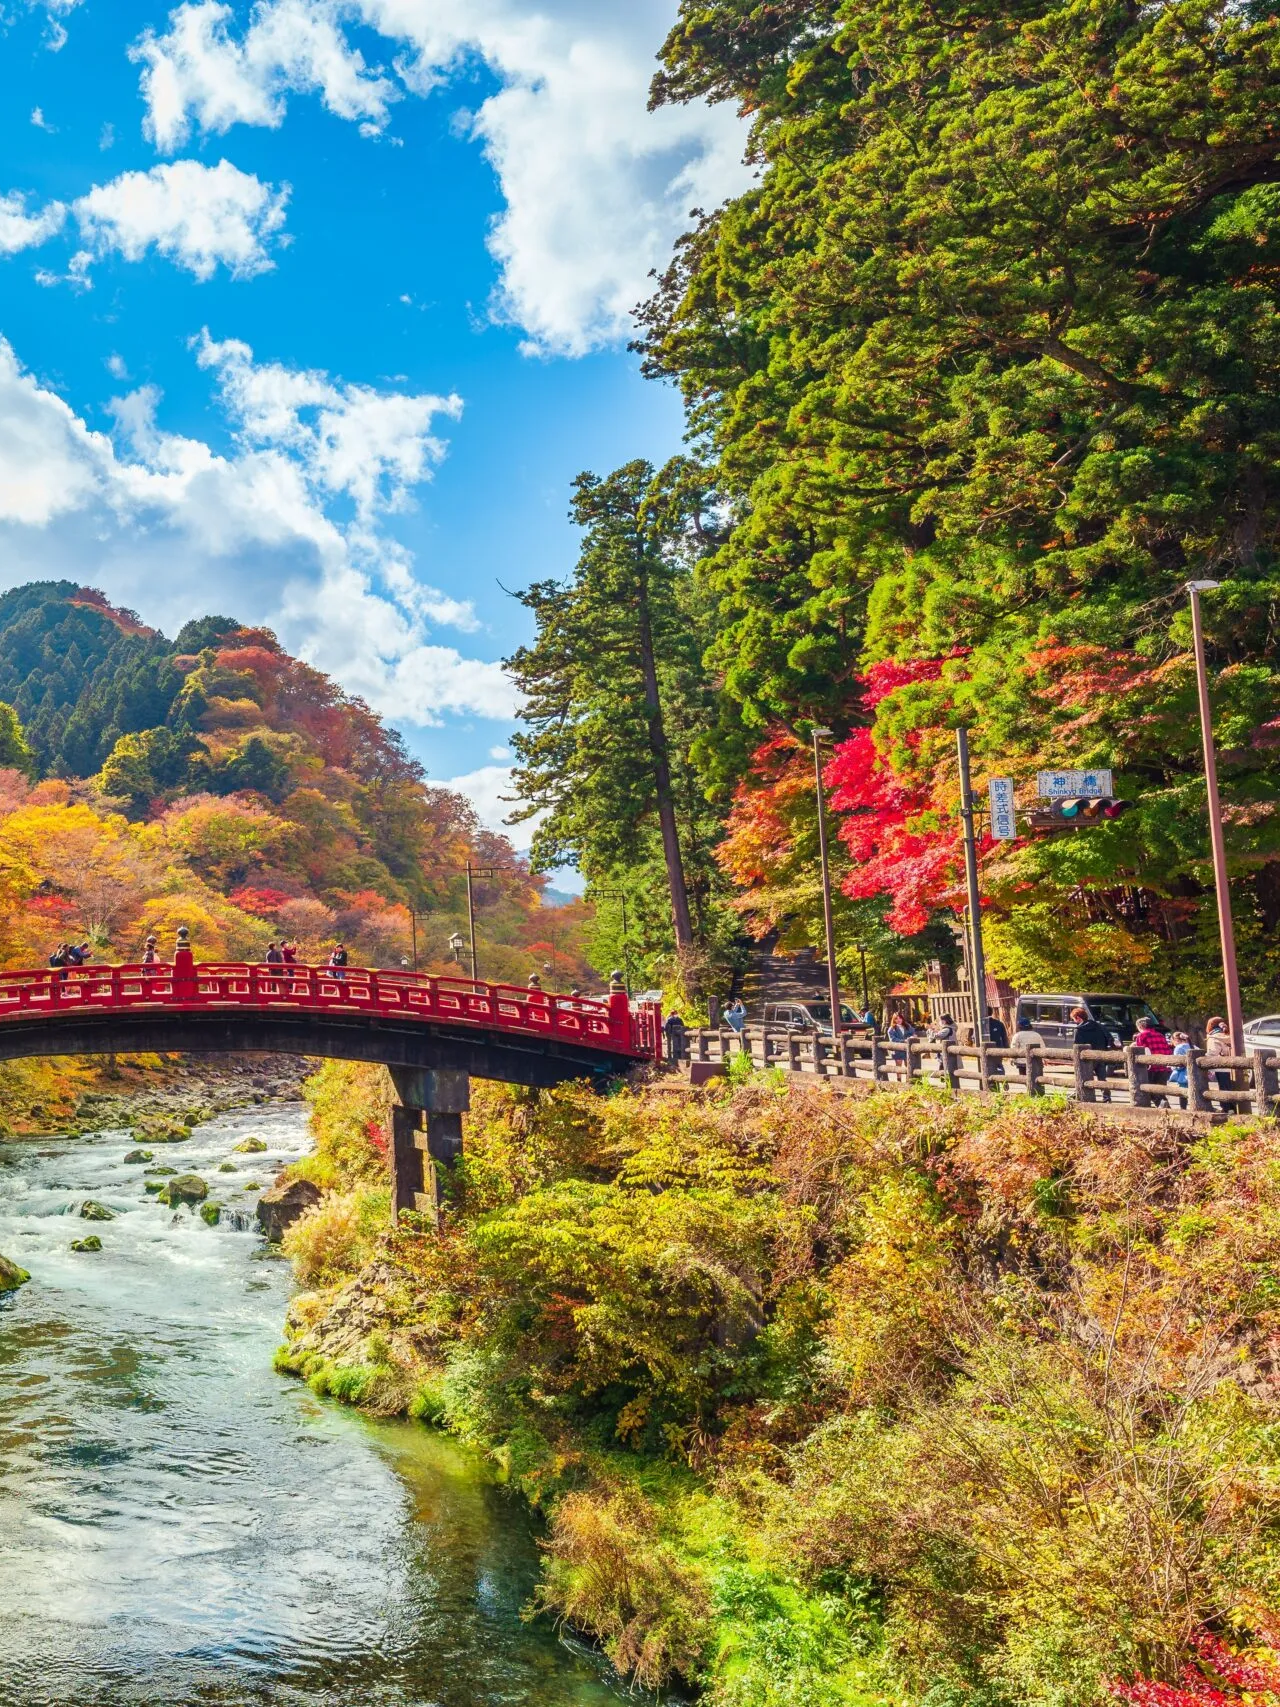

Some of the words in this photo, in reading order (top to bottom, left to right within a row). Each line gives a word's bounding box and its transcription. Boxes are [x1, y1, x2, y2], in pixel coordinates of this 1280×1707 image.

[995, 781, 1010, 836] 時差式信号
